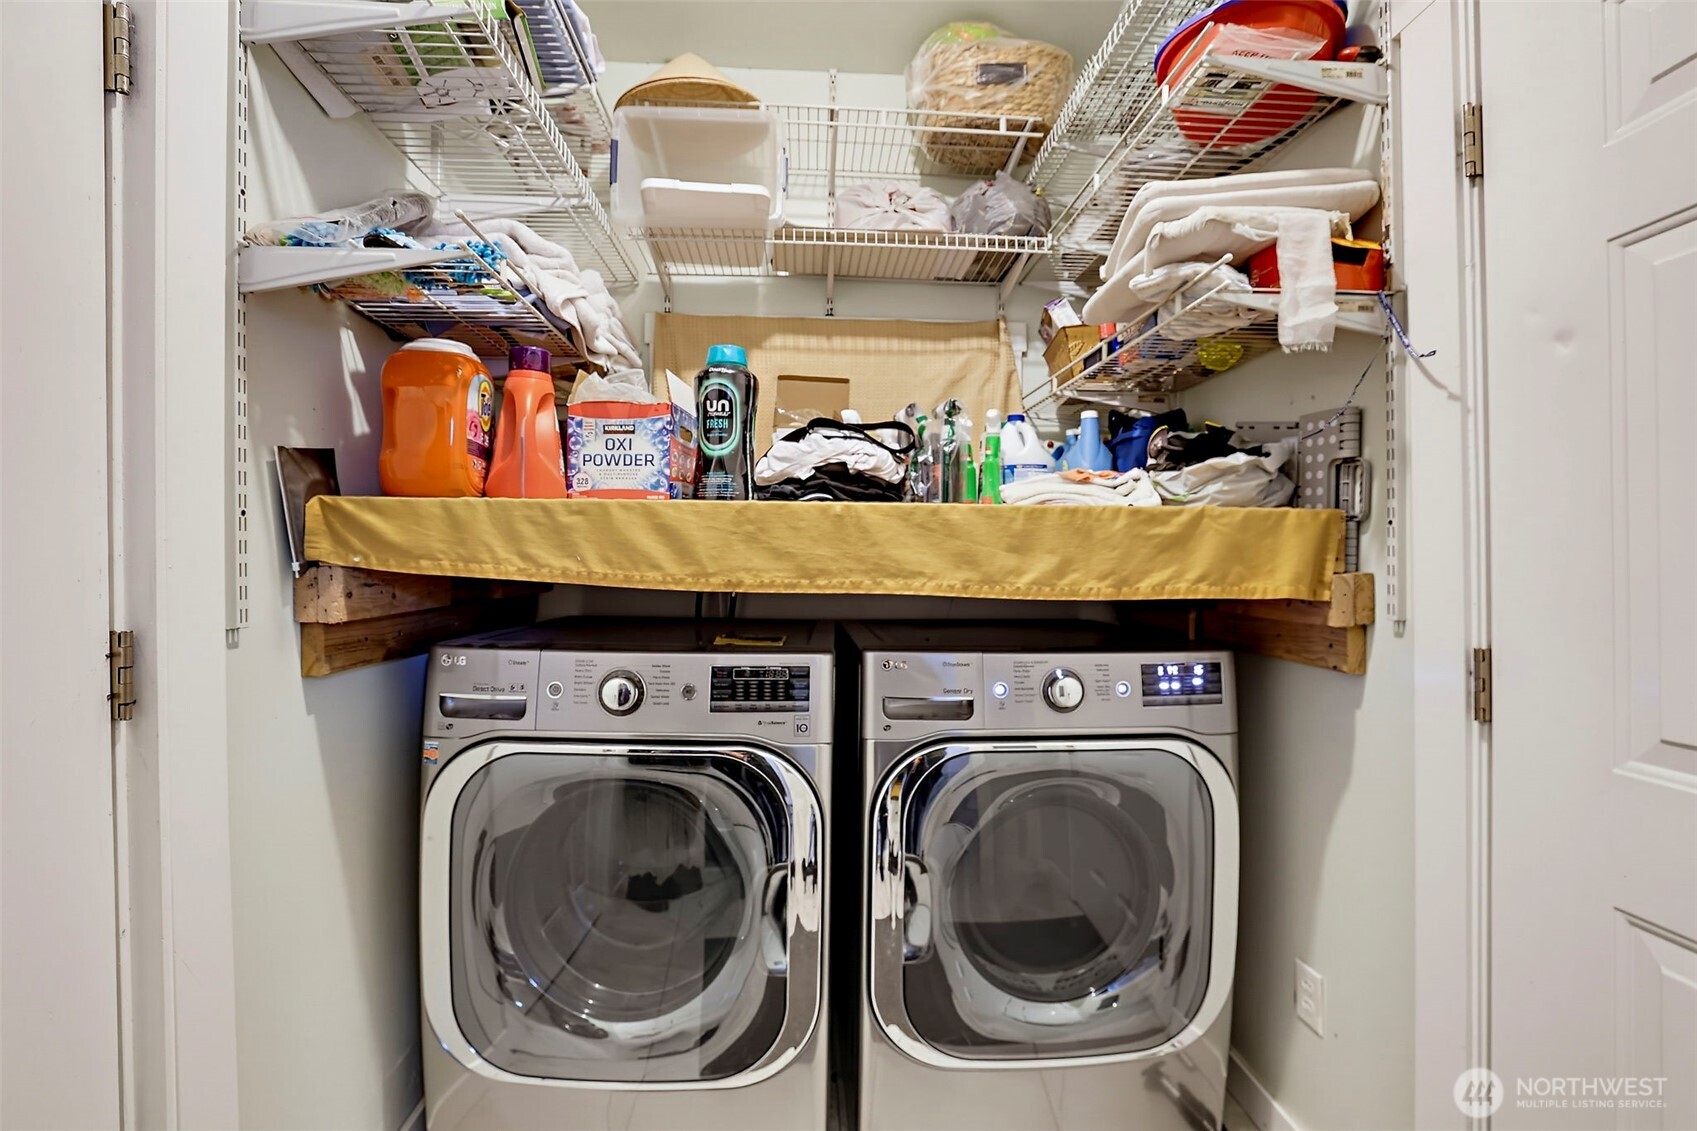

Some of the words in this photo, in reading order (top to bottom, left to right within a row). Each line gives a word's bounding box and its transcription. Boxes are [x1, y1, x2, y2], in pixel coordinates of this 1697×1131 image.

[706, 418, 729, 429] FRESH
[605, 438, 632, 451] OXI
[582, 453, 655, 467] POWDER
[576, 477, 589, 485] 328
[453, 655, 467, 666] LG
[963, 687, 973, 695] Dry
